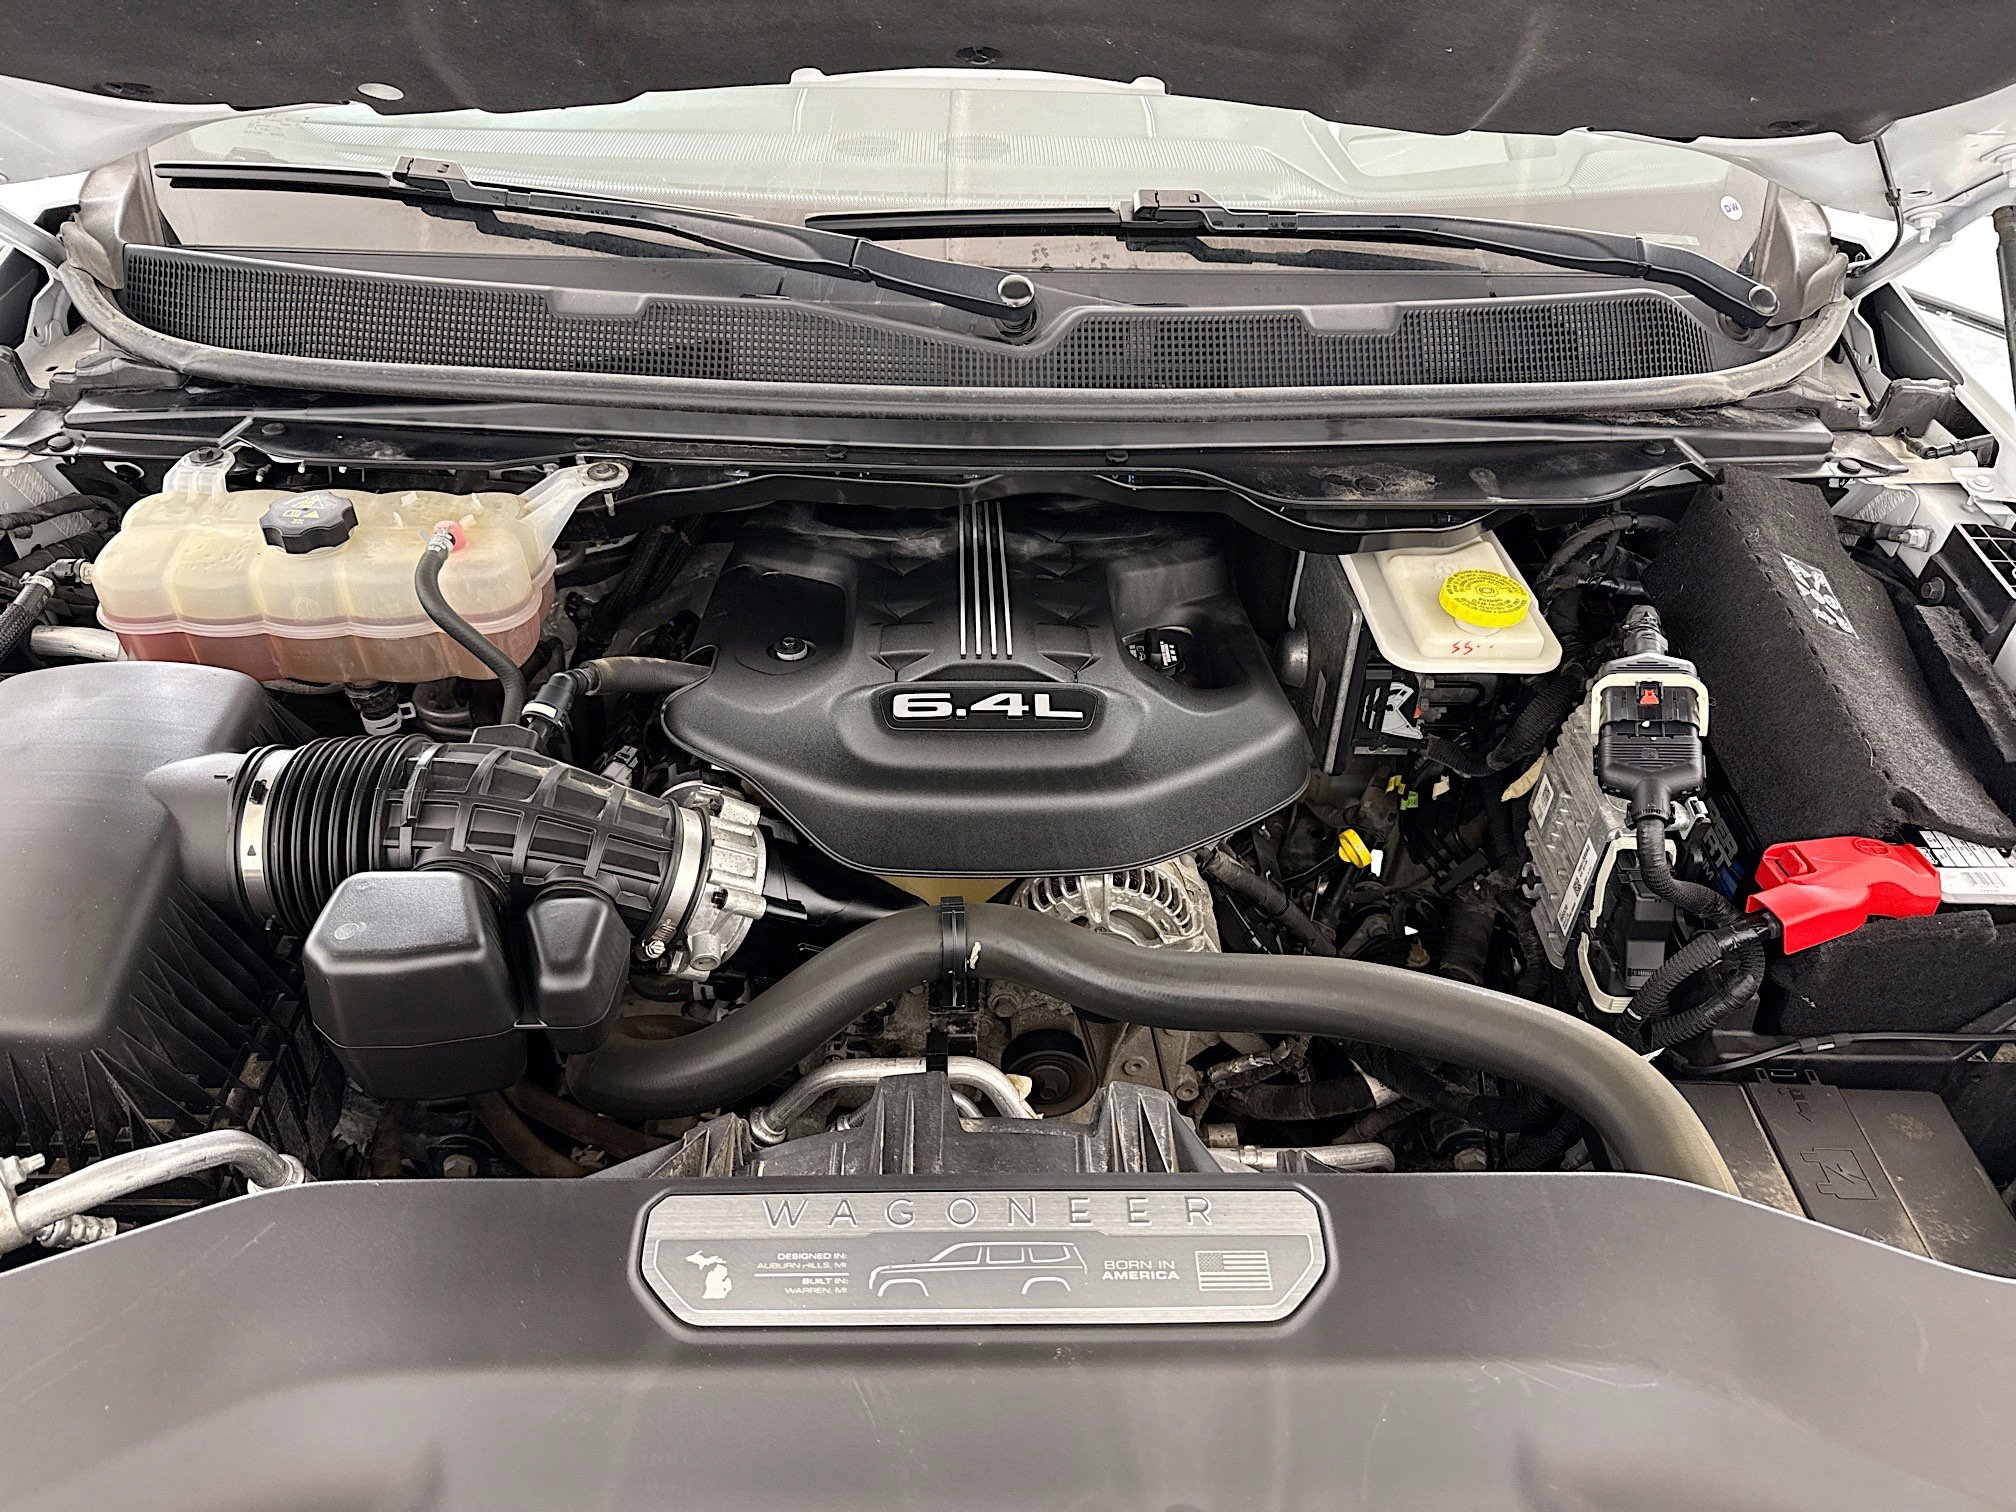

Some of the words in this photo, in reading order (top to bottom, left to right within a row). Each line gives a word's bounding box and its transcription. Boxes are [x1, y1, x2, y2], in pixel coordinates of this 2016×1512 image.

[1723, 203, 1739, 213] DW
[893, 693, 1083, 720] 6.4L
[763, 1196, 1214, 1229] WAGONEER
[1104, 1260, 1152, 1270] BORN
[1158, 1260, 1176, 1270] IN
[1101, 1270, 1180, 1280] AMERICA
[834, 1286, 848, 1294] MI
